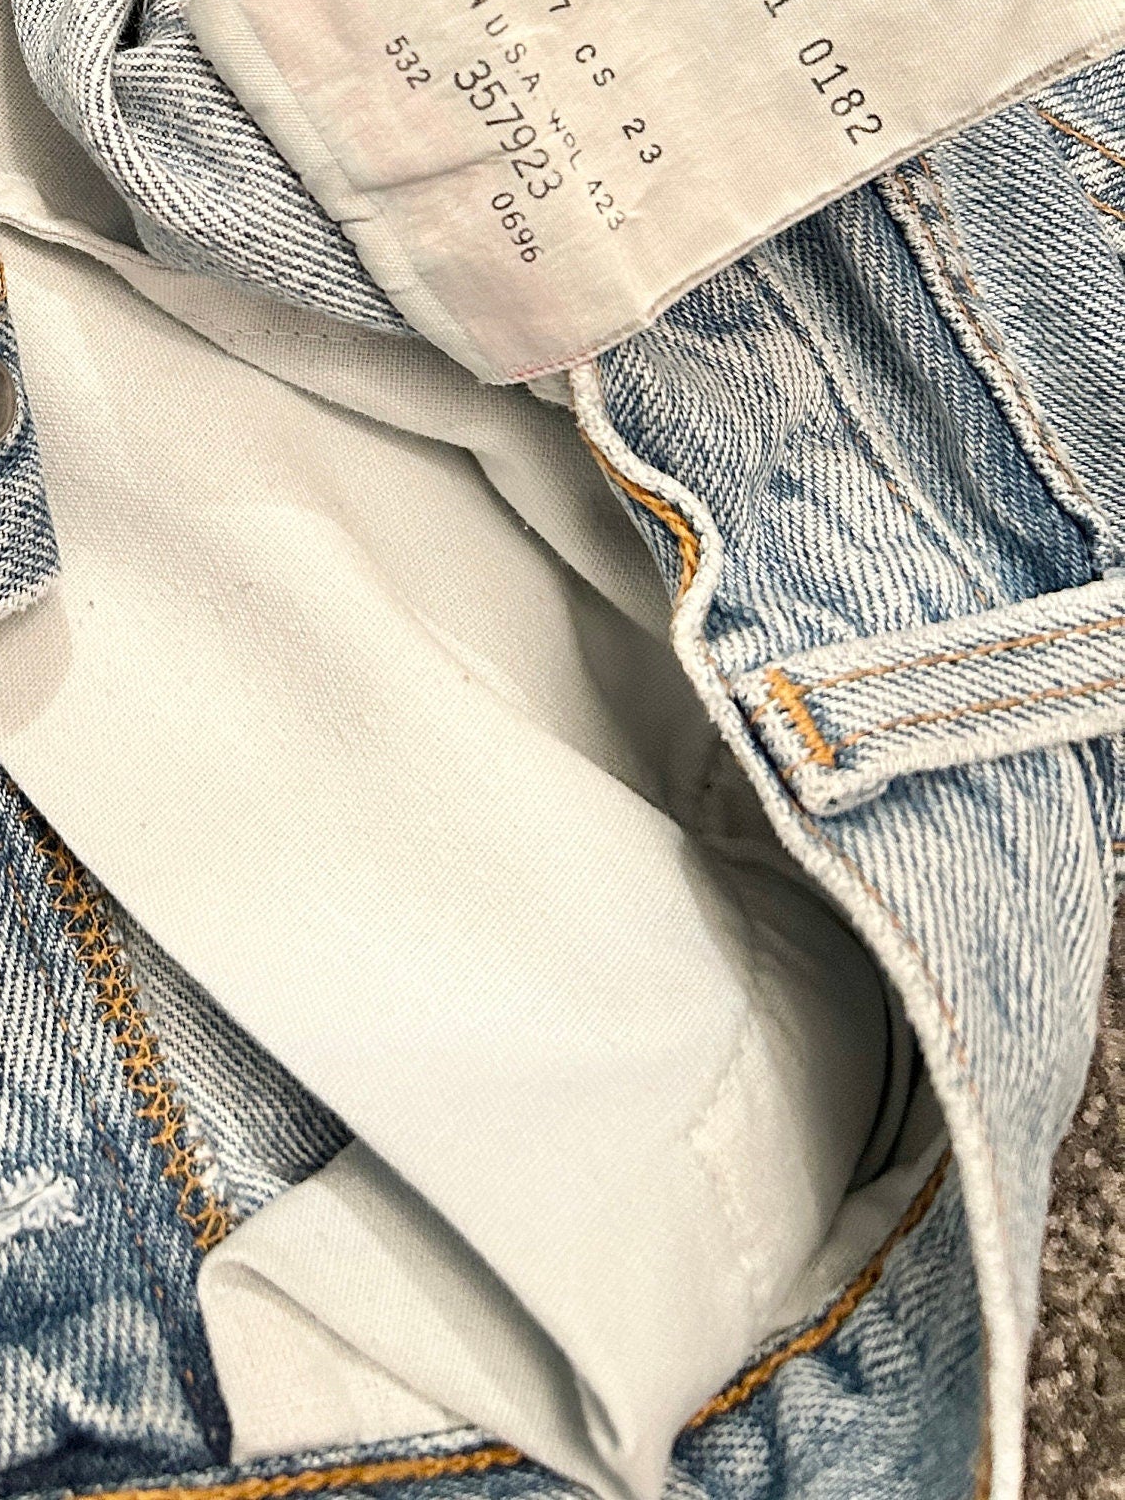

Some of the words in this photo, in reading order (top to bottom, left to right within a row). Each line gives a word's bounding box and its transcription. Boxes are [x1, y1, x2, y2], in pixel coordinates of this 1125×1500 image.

[384, 35, 432, 92] 532
[490, 193, 545, 263] 0696
[451, 58, 564, 201] 357923
[797, 40, 883, 146] 0182
